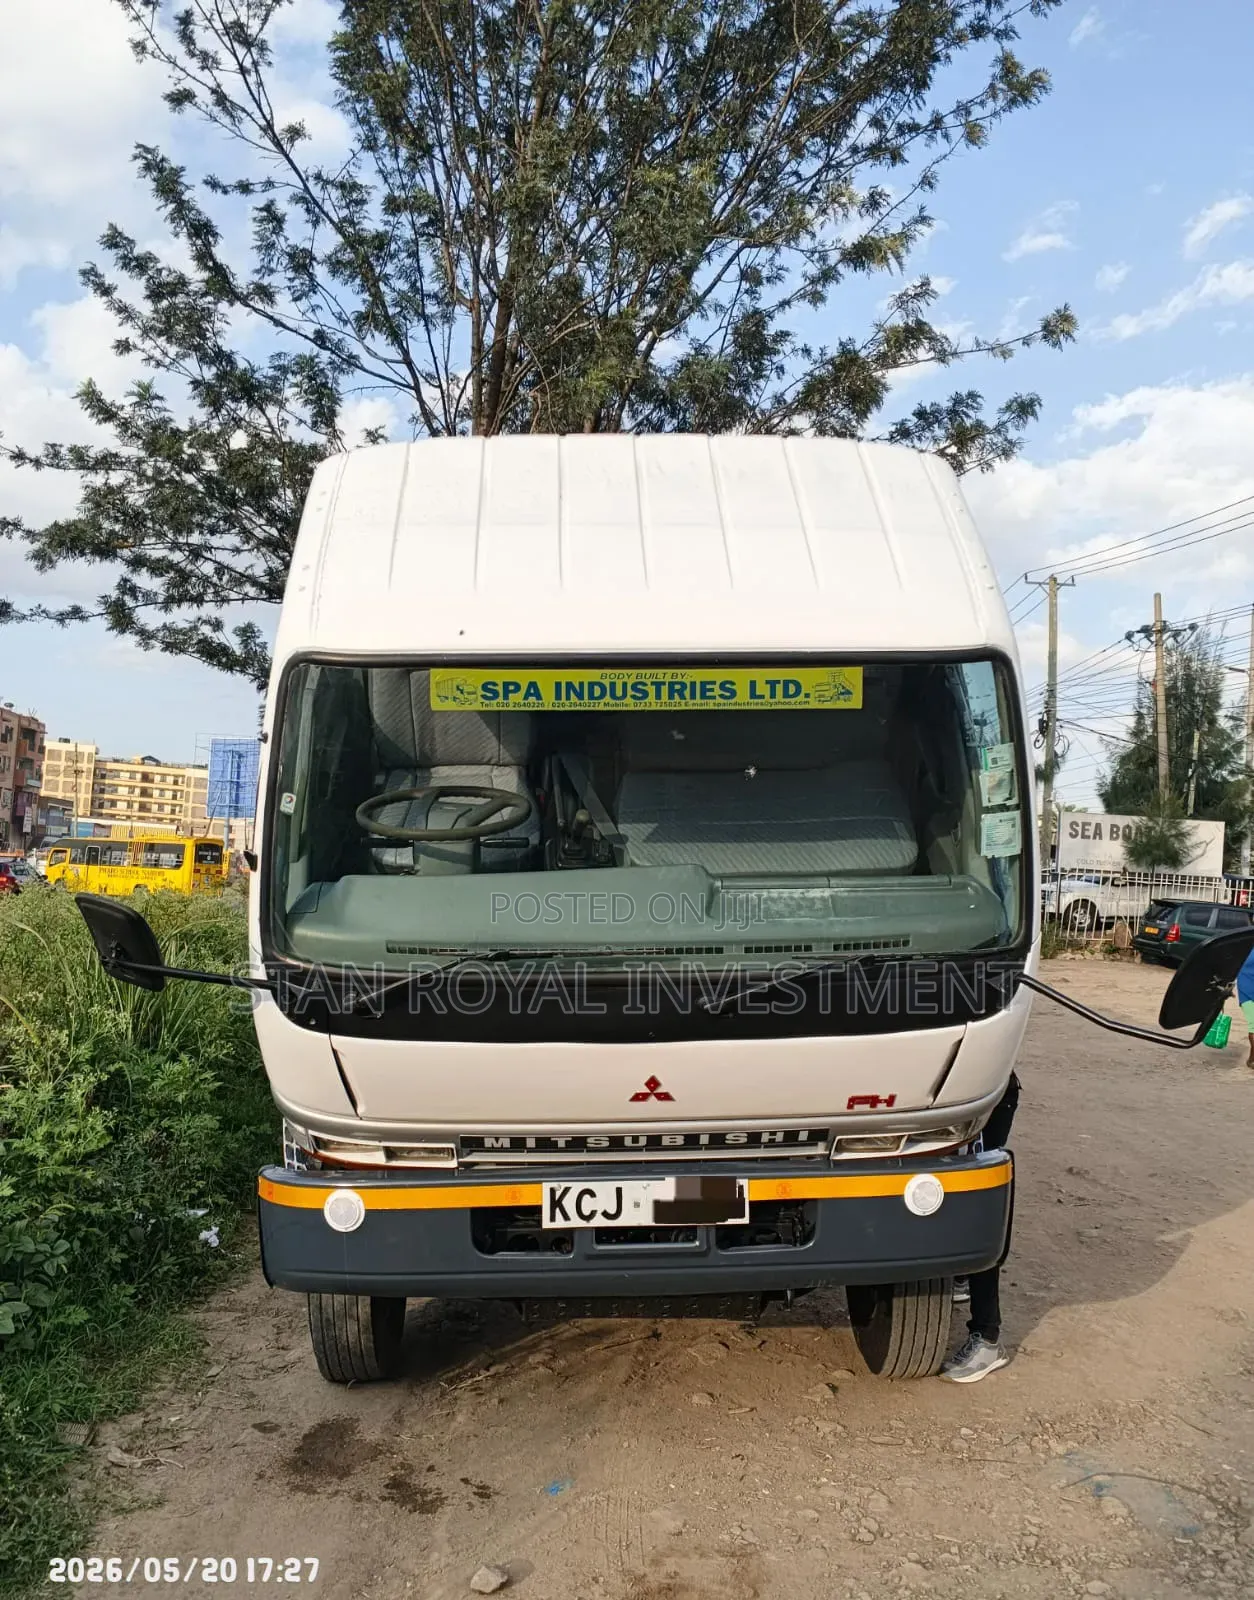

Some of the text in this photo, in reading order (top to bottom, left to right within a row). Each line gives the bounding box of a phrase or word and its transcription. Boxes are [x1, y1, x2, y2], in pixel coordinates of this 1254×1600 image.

[600, 672, 633, 681] BODY
[635, 672, 668, 680] BUILT
[480, 679, 811, 702] SPA INDUSTRIES LTD.
[1068, 820, 1104, 842] SEA
[846, 1093, 897, 1110] FH
[483, 1129, 810, 1150] MITSUBISHI
[549, 1186, 623, 1224] KCJ
